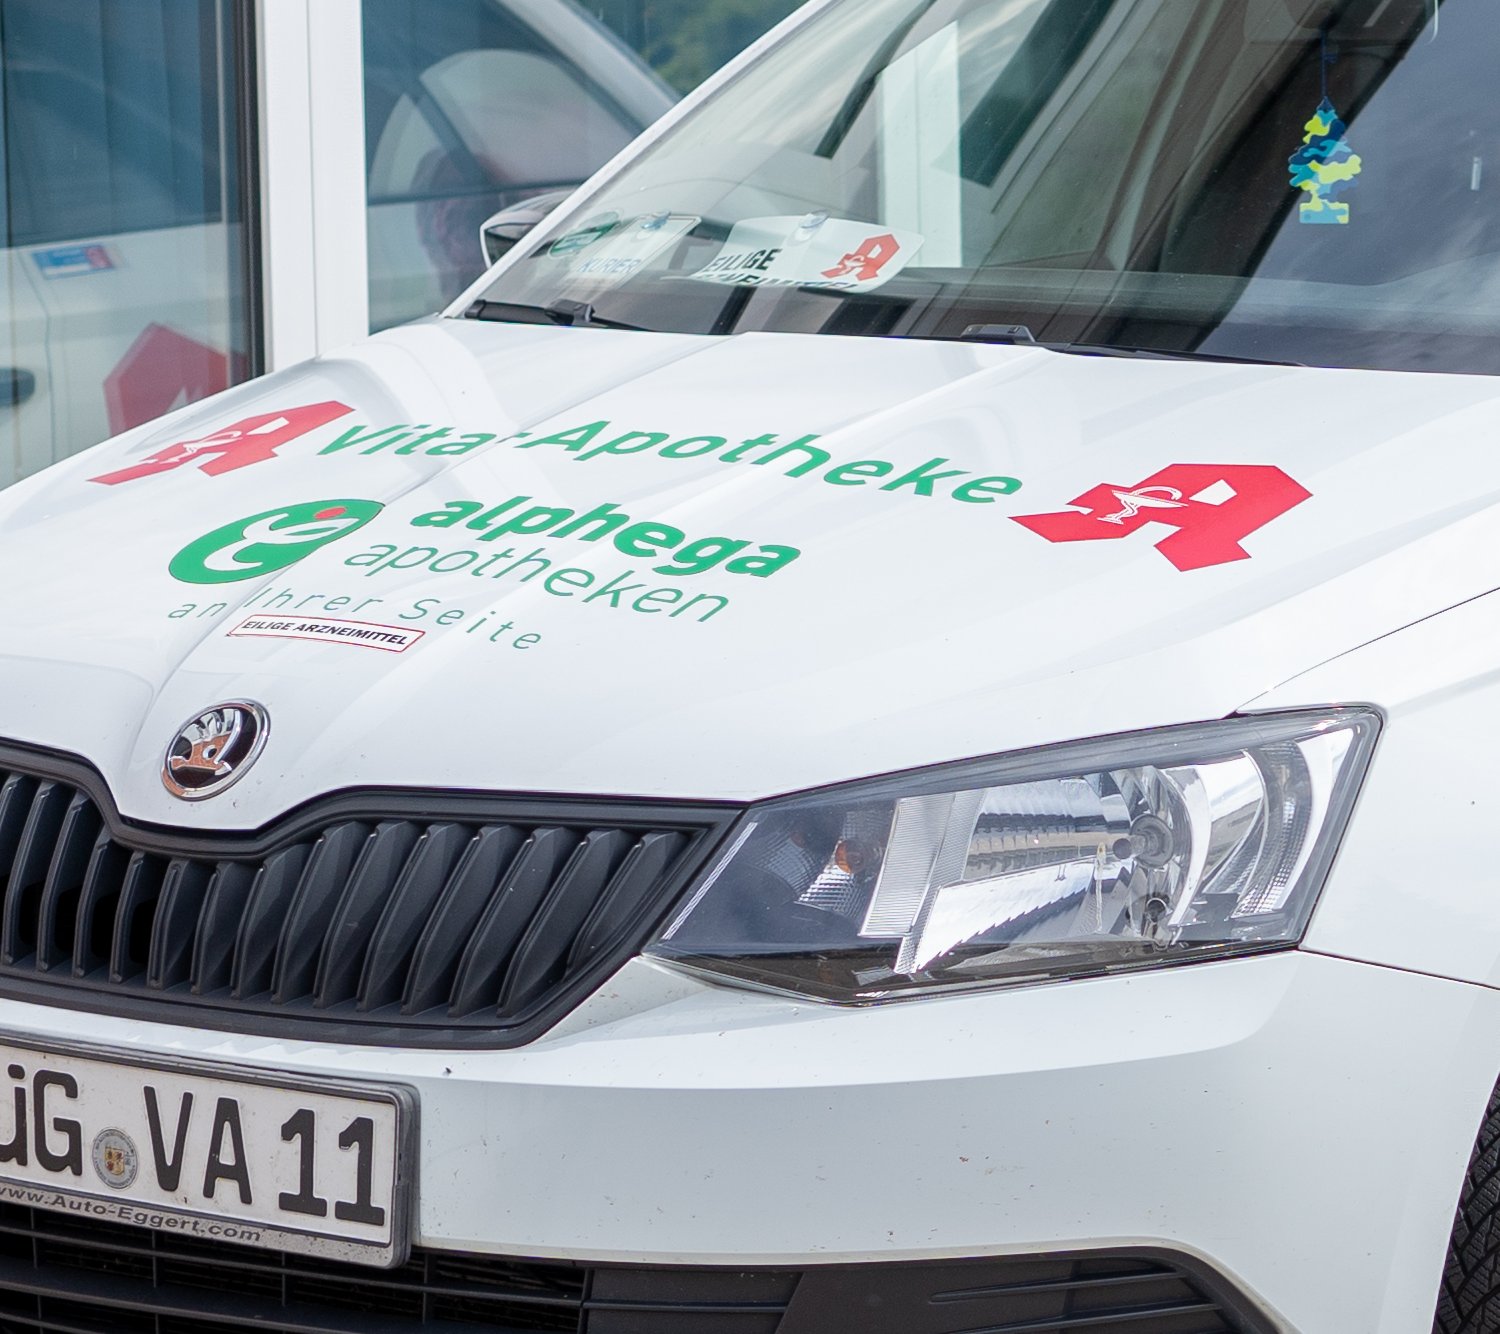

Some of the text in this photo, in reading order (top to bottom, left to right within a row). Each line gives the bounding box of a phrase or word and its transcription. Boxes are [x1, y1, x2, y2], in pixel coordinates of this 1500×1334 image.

[577, 257, 641, 274] KURIER
[700, 248, 783, 272] EILIGE
[316, 419, 1023, 505] Vita-Apotheke
[409, 495, 801, 578] alphega
[343, 540, 730, 623] apotheken
[168, 587, 542, 650] an Ihrer Seite
[243, 620, 409, 646] EILIGE ARZNEIMITTEL
[143, 1085, 254, 1206] VA
[277, 1109, 387, 1227] 11
